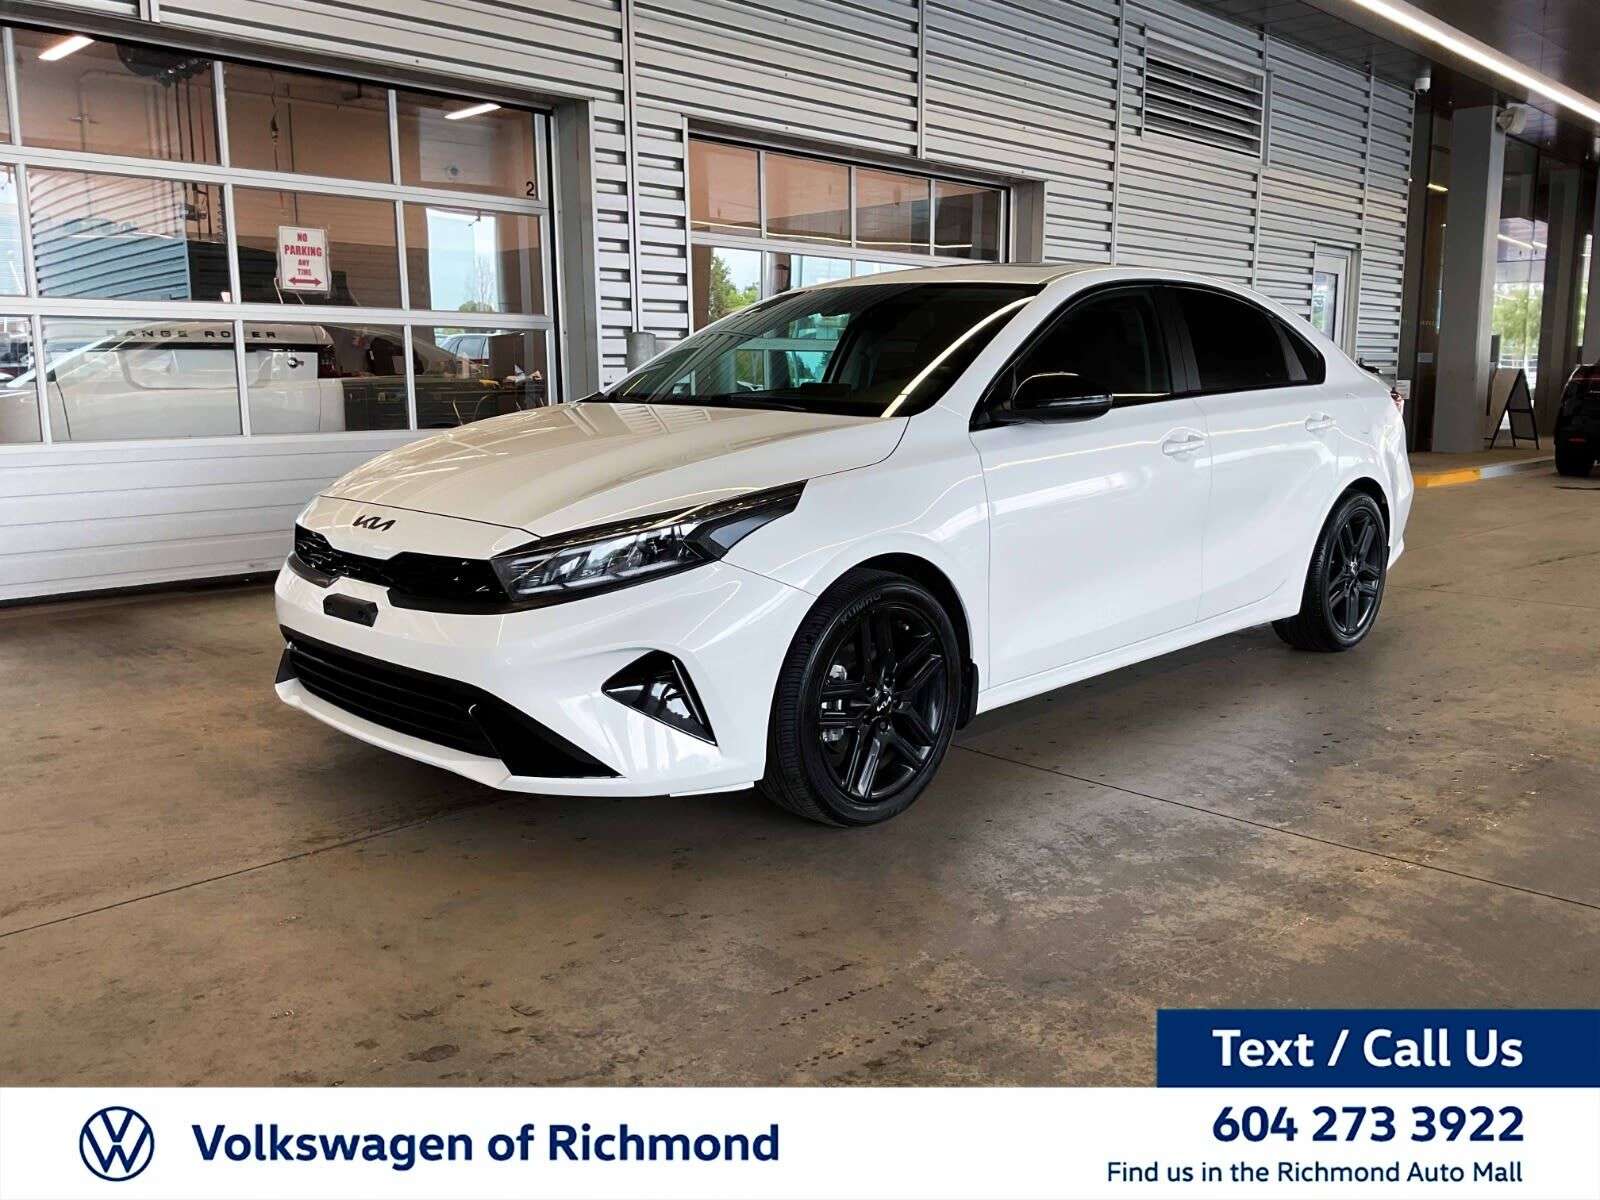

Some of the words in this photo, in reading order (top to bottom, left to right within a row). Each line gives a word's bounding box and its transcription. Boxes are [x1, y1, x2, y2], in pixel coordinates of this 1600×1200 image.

[526, 181, 535, 196] 2
[297, 232, 308, 242] NO
[284, 245, 323, 257] PARKING
[298, 259, 310, 267] ANY
[297, 268, 312, 276] TIME
[204, 330, 277, 338] ROER
